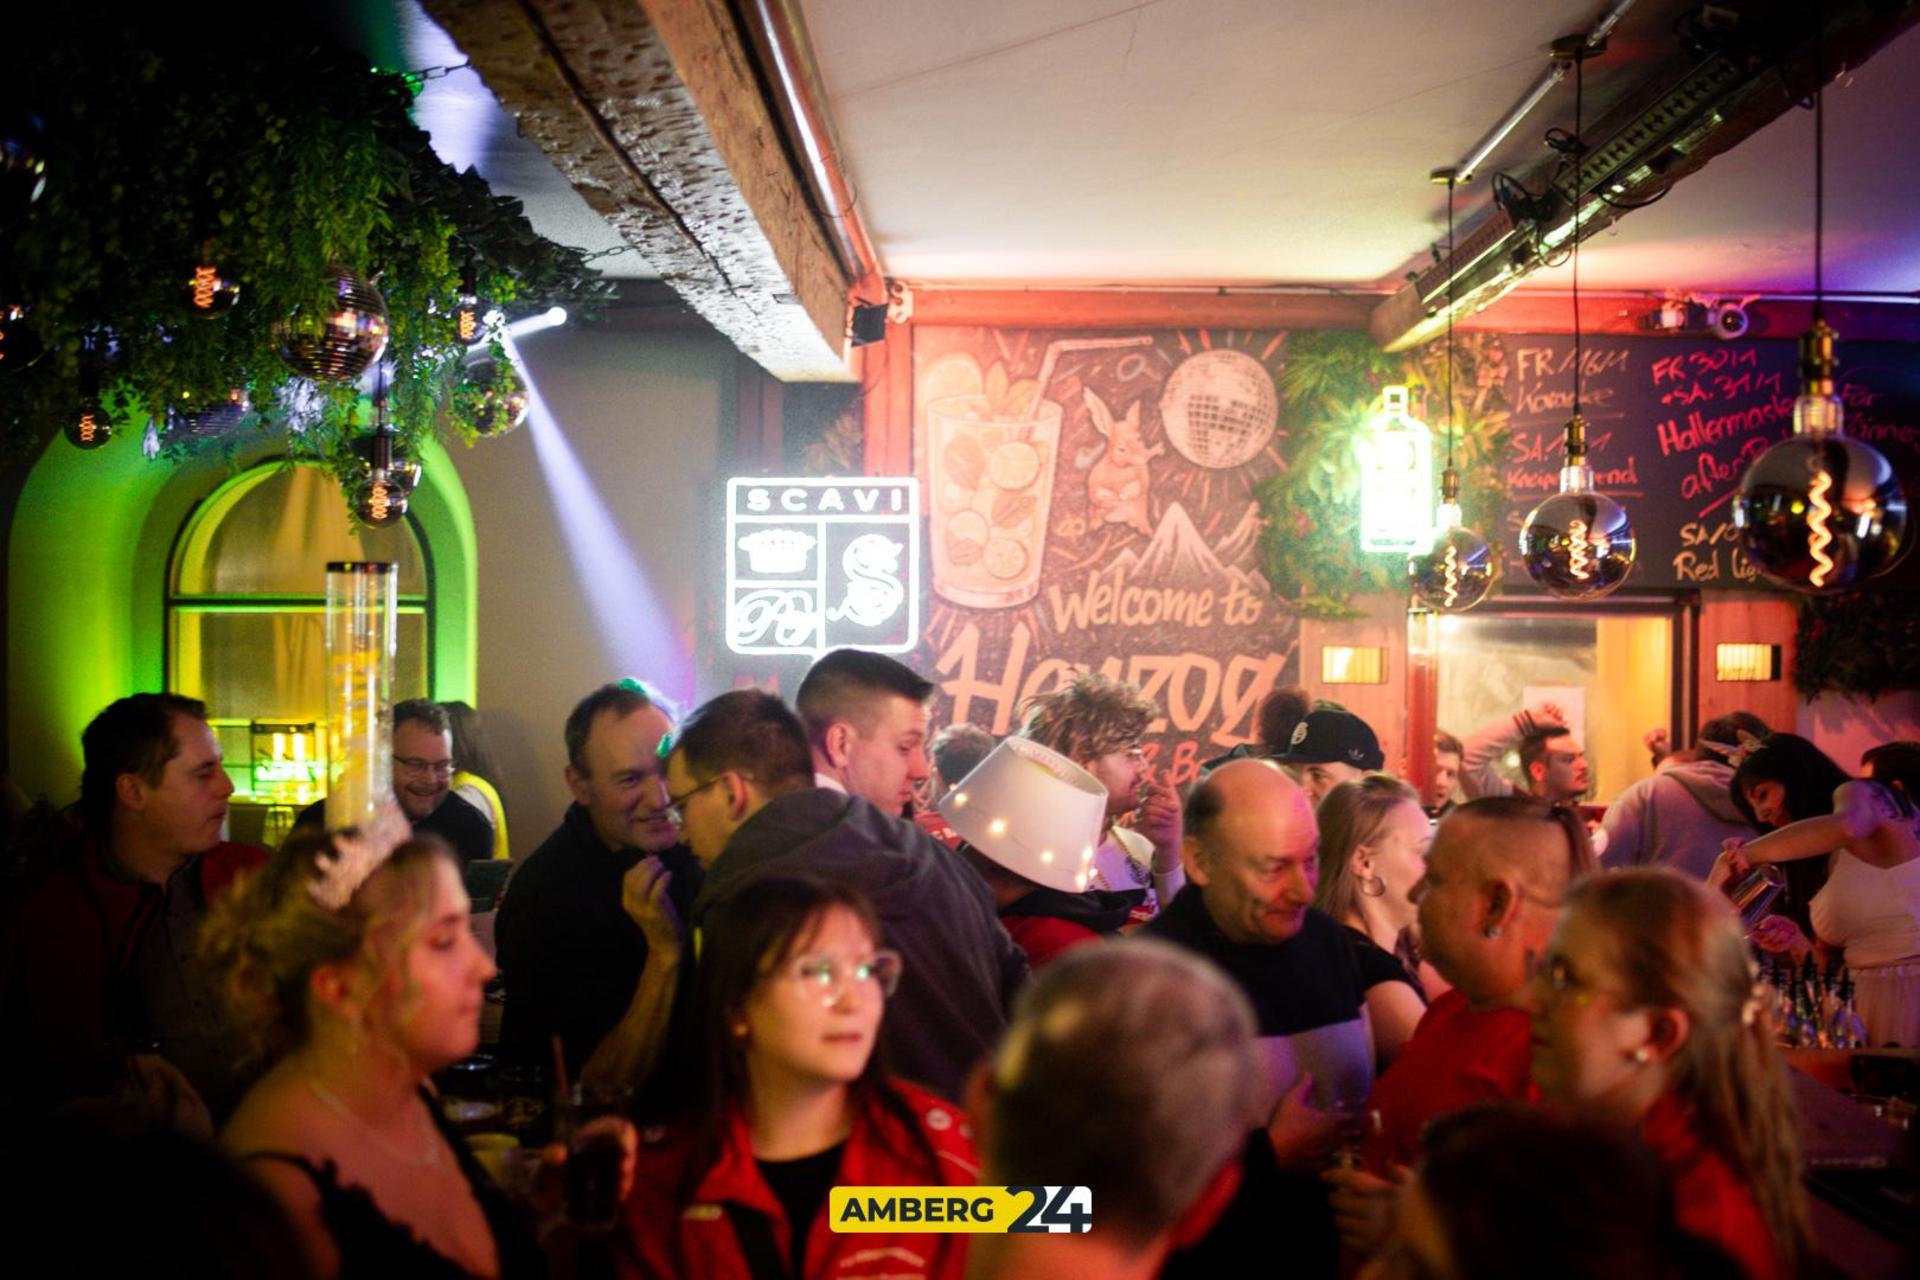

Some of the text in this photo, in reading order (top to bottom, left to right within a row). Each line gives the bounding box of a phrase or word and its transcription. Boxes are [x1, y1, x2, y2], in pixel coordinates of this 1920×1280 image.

[747, 488, 902, 512] SCAVI
[1673, 549, 1720, 581] Red
[1049, 567, 1263, 633] Welcome to
